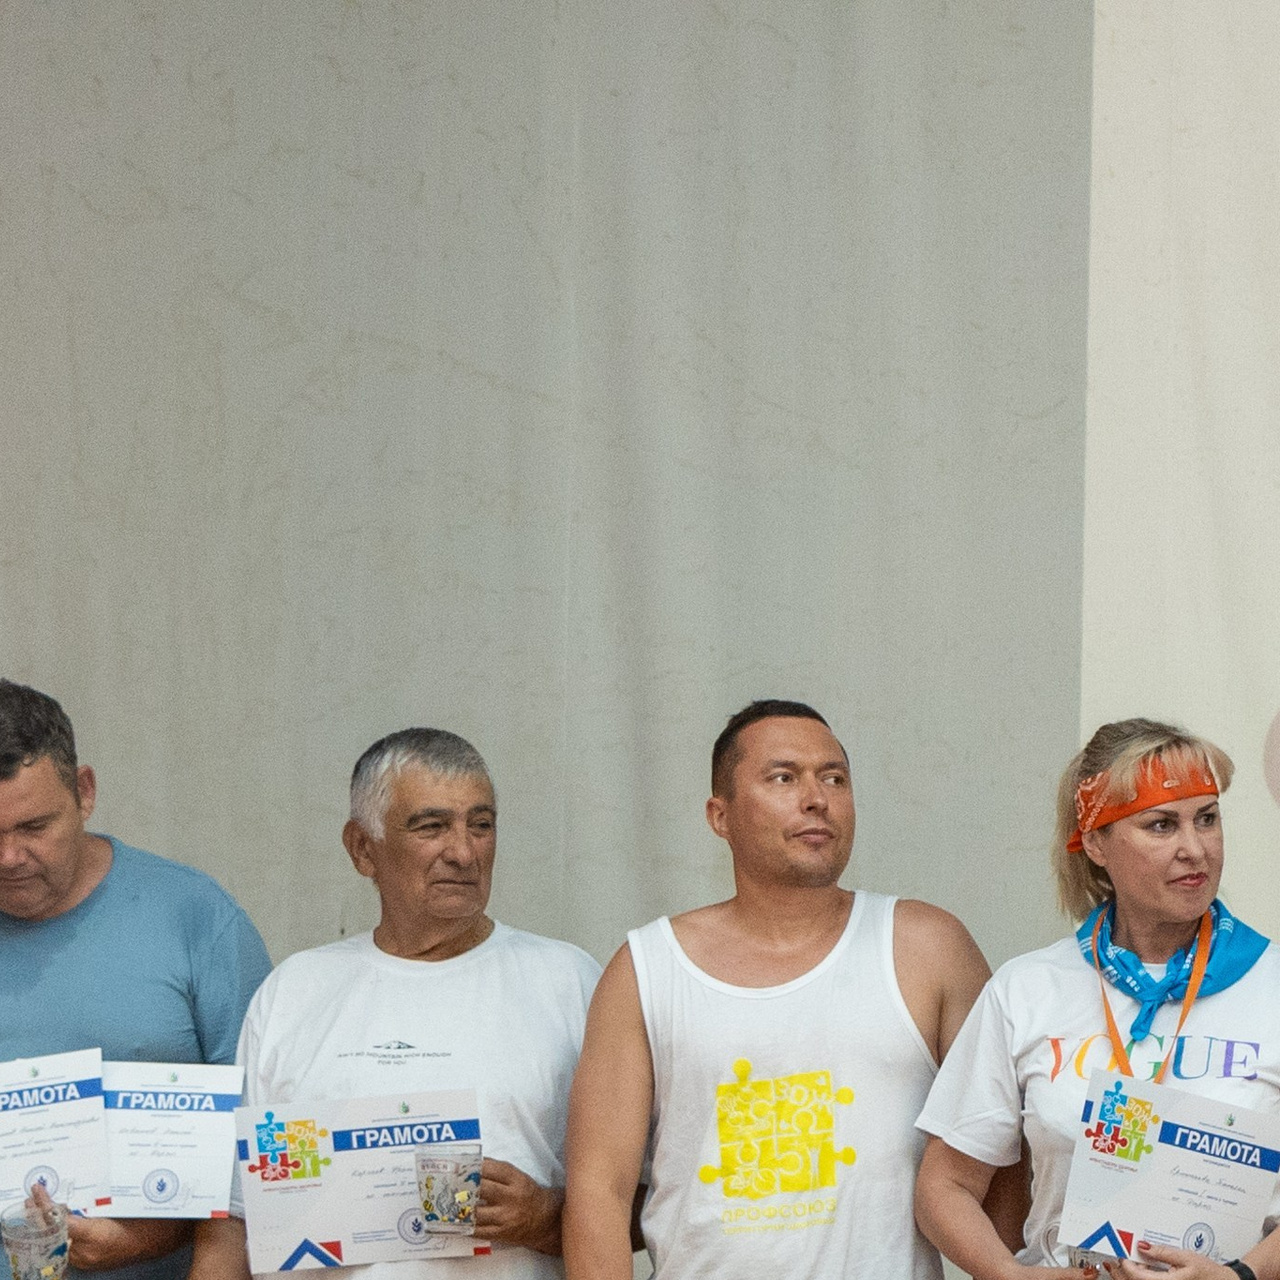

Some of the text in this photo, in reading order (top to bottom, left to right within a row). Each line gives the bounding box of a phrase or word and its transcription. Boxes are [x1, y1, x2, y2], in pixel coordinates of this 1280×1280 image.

[1046, 1032, 1260, 1083] VOGUE
[117, 1092, 216, 1111] ГРАМОТА
[351, 1123, 456, 1148] ГРАМОТА
[1174, 1127, 1261, 1167] ГРАМОТА
[722, 1197, 837, 1223] ПРОФСОЮЗ
